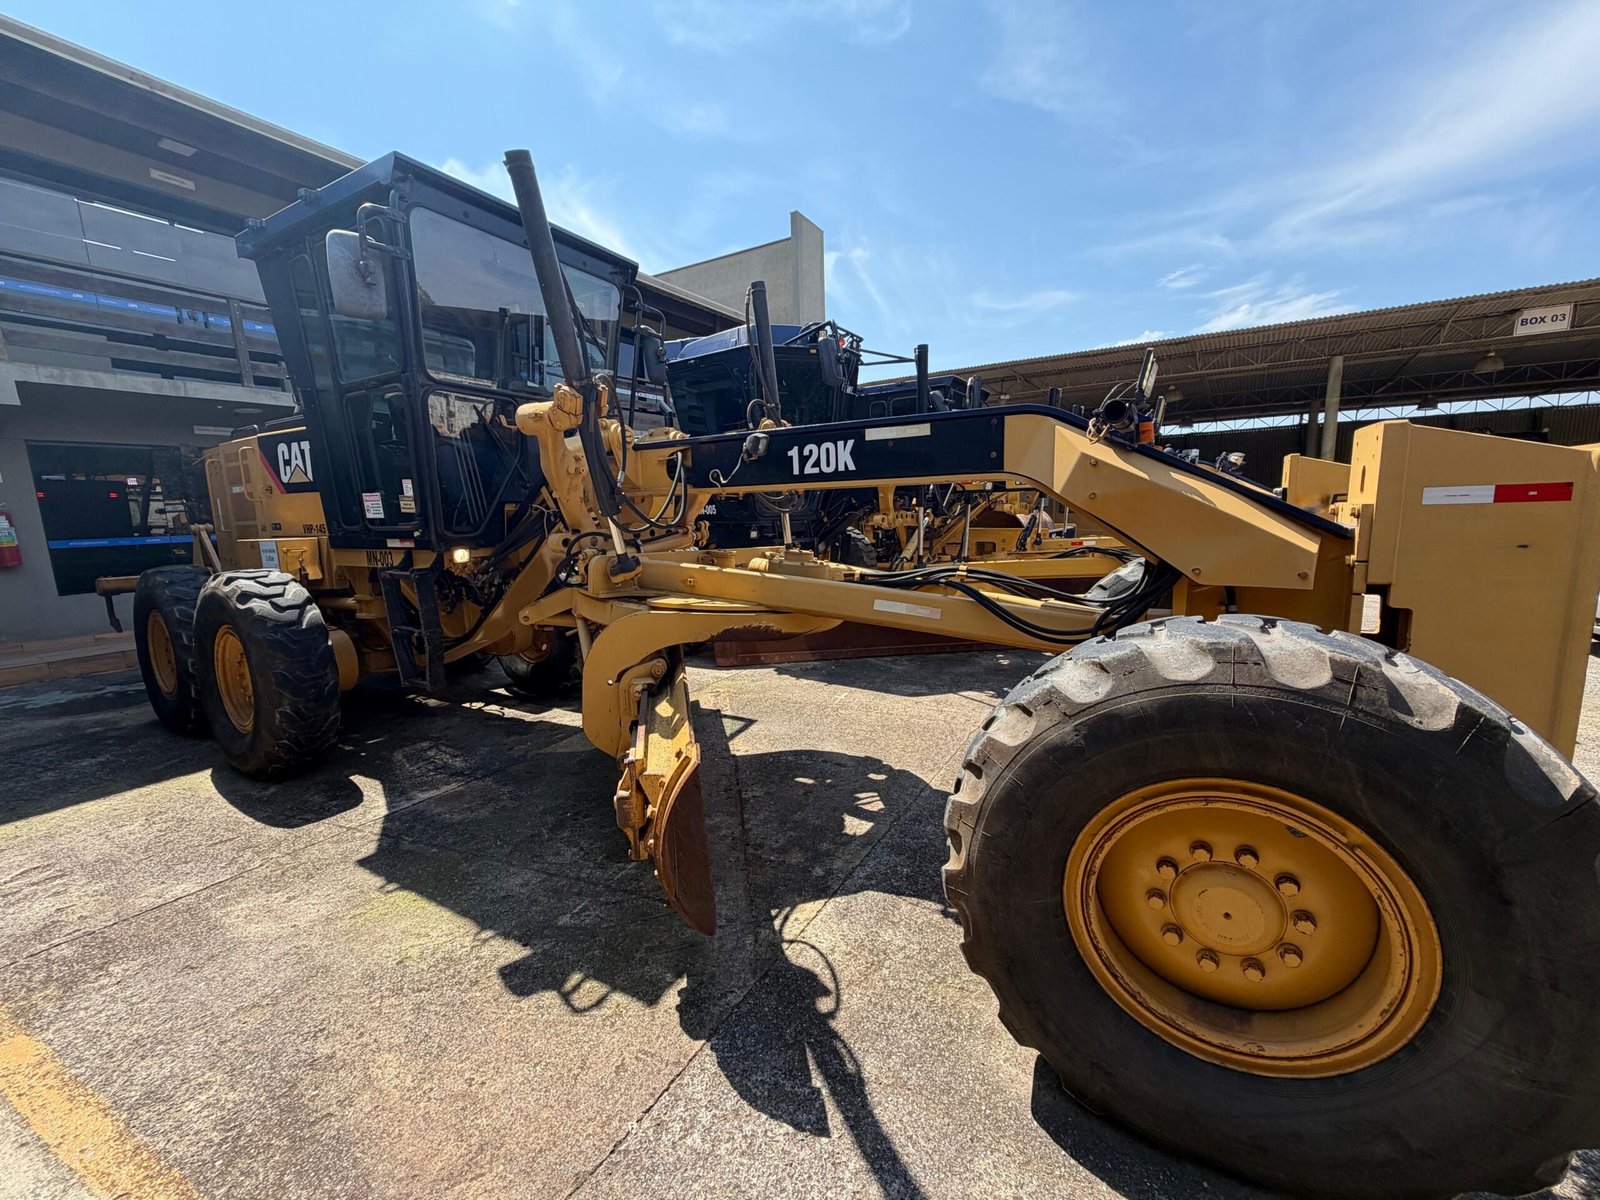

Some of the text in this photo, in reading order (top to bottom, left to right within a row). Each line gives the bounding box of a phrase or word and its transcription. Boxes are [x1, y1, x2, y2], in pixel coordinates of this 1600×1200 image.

[1520, 313, 1566, 326] BOX 03
[277, 440, 314, 484] CAT
[787, 439, 856, 475] 120K
[302, 523, 327, 535] VHP-145
[366, 550, 394, 567] MN-003
